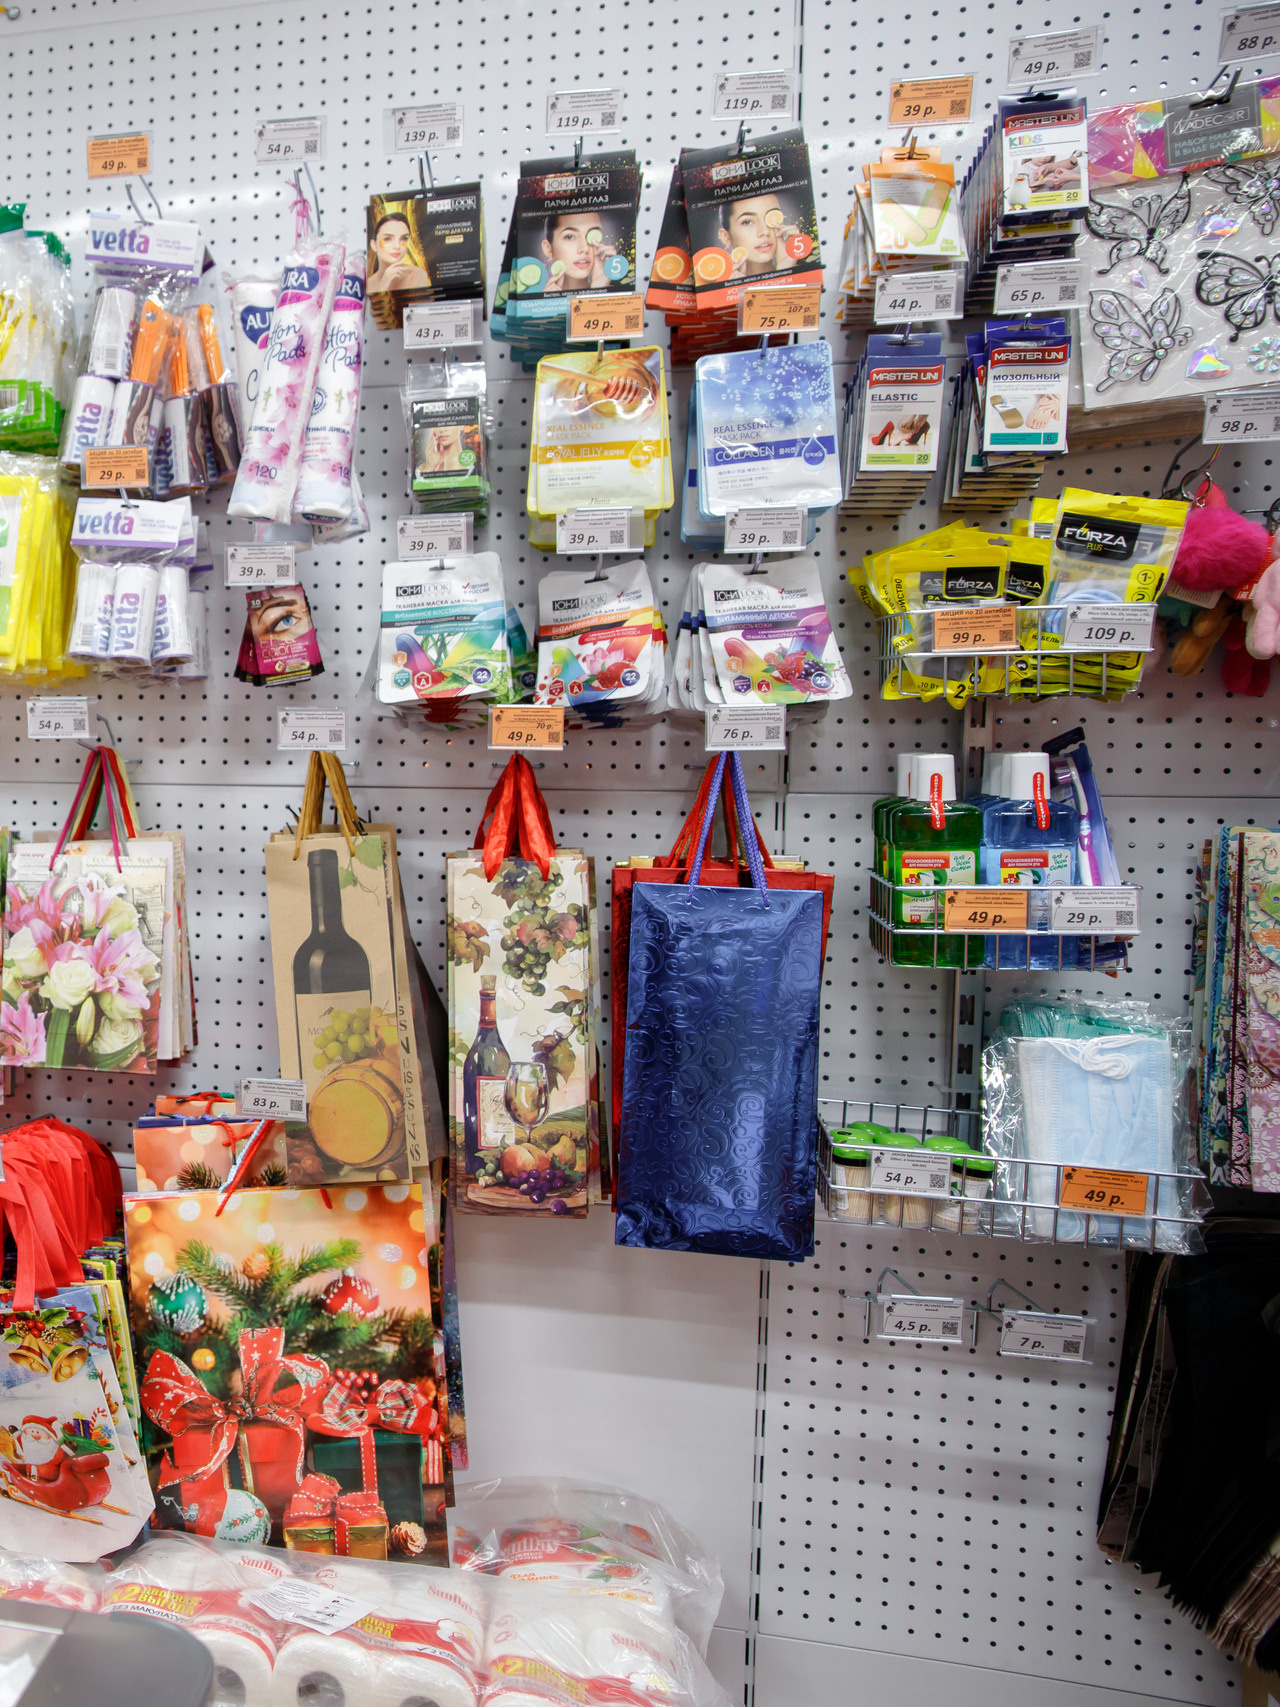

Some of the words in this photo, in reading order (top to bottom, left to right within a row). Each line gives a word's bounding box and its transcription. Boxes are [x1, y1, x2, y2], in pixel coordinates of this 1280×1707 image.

[1237, 36, 1259, 51] 88
[1261, 36, 1277, 50] р.
[1024, 61, 1043, 74] 49
[1045, 62, 1059, 74] р.
[724, 98, 748, 110] 119
[750, 100, 762, 111] р.
[903, 104, 921, 117] 39
[923, 106, 936, 118] р.
[557, 116, 579, 128] 119
[581, 117, 593, 128] р.
[1008, 116, 1056, 128] MASTER
[1060, 113, 1080, 122] UNI
[404, 130, 426, 142] 139
[428, 132, 439, 142] р.
[1009, 134, 1042, 147] KIDS
[1175, 136, 1207, 148] НАБОР
[267, 144, 281, 154] 54
[283, 145, 294, 156] р.
[1183, 146, 1207, 156] ВИДЕ
[715, 163, 744, 178] ЮНИ
[747, 155, 778, 172] LOOK
[547, 179, 574, 191] ЮНИ
[577, 174, 607, 188] LOOK
[714, 186, 740, 196] ПАТЧИ
[742, 181, 759, 191] ДЛЯ
[761, 176, 782, 188] ГЛАЗ
[545, 198, 569, 208] ПАТЧИ
[571, 197, 587, 206] ДЛЯ
[589, 194, 608, 204] ГЛАЗ
[92, 228, 150, 254] vetta
[793, 238, 804, 253] 5
[611, 259, 621, 274] 5
[1011, 290, 1029, 302] 65
[1031, 292, 1045, 303] р.
[889, 298, 906, 310] 44
[908, 300, 922, 311] р.
[583, 319, 600, 330] 49
[602, 321, 613, 332] р.
[760, 316, 776, 328] 75
[778, 318, 790, 329] р.
[415, 328, 430, 338] 43
[432, 329, 444, 340] р.
[264, 336, 306, 369] Pads
[994, 352, 1042, 361] MASTER
[1045, 351, 1064, 359] UNI
[873, 372, 919, 381] MASTER
[921, 372, 939, 380] UNI
[546, 424, 568, 433] REAL
[569, 422, 605, 431] ESSENCE
[713, 424, 734, 434] REAL
[1220, 420, 1241, 433] 98
[1243, 422, 1258, 434] р.
[547, 447, 578, 461] ROYAL
[579, 446, 602, 459] JELLY
[716, 446, 775, 462] COLLAGEN
[99, 470, 113, 480] 29
[115, 472, 125, 481] р.
[255, 465, 278, 480] 120
[78, 512, 134, 535] vetta
[569, 533, 584, 544] 39
[587, 535, 598, 546] р.
[1064, 527, 1127, 547] FORZA
[397, 586, 420, 596] ЮНИ
[423, 584, 449, 593] LOOK
[948, 580, 994, 589] FORZA
[716, 591, 738, 600] ЮНИ
[741, 589, 766, 599] LOOK
[553, 600, 577, 610] ЮНИ
[580, 594, 605, 607] LOOK
[114, 593, 140, 652] vetta
[717, 613, 767, 623] ВИТАМИННЫЙ
[769, 611, 797, 620] ДЕТОКС
[952, 632, 970, 644] 99
[972, 634, 985, 645] р.
[1084, 627, 1116, 640] 109
[1119, 631, 1135, 644] р.
[476, 671, 488, 679] 22
[954, 684, 966, 699] 2
[39, 720, 51, 730] 54
[54, 722, 64, 731] р.
[507, 731, 523, 741] 49
[525, 734, 536, 744] р.
[723, 728, 739, 739] 76
[741, 730, 753, 741] р.
[968, 911, 988, 924] 49
[991, 914, 1007, 927] р.
[1067, 912, 1085, 924] 29
[1088, 915, 1102, 926] р.
[252, 1098, 267, 1107] 83
[269, 1101, 280, 1110] р.
[884, 1172, 901, 1183] 54
[904, 1176, 916, 1186] р.
[1084, 1190, 1106, 1203] 49
[1108, 1195, 1124, 1207] р.
[894, 1320, 916, 1332] 4,5
[918, 1324, 931, 1334] р.
[1020, 1337, 1030, 1346] 7
[1031, 1340, 1045, 1350] р.
[240, 1555, 284, 1577] SunDay
